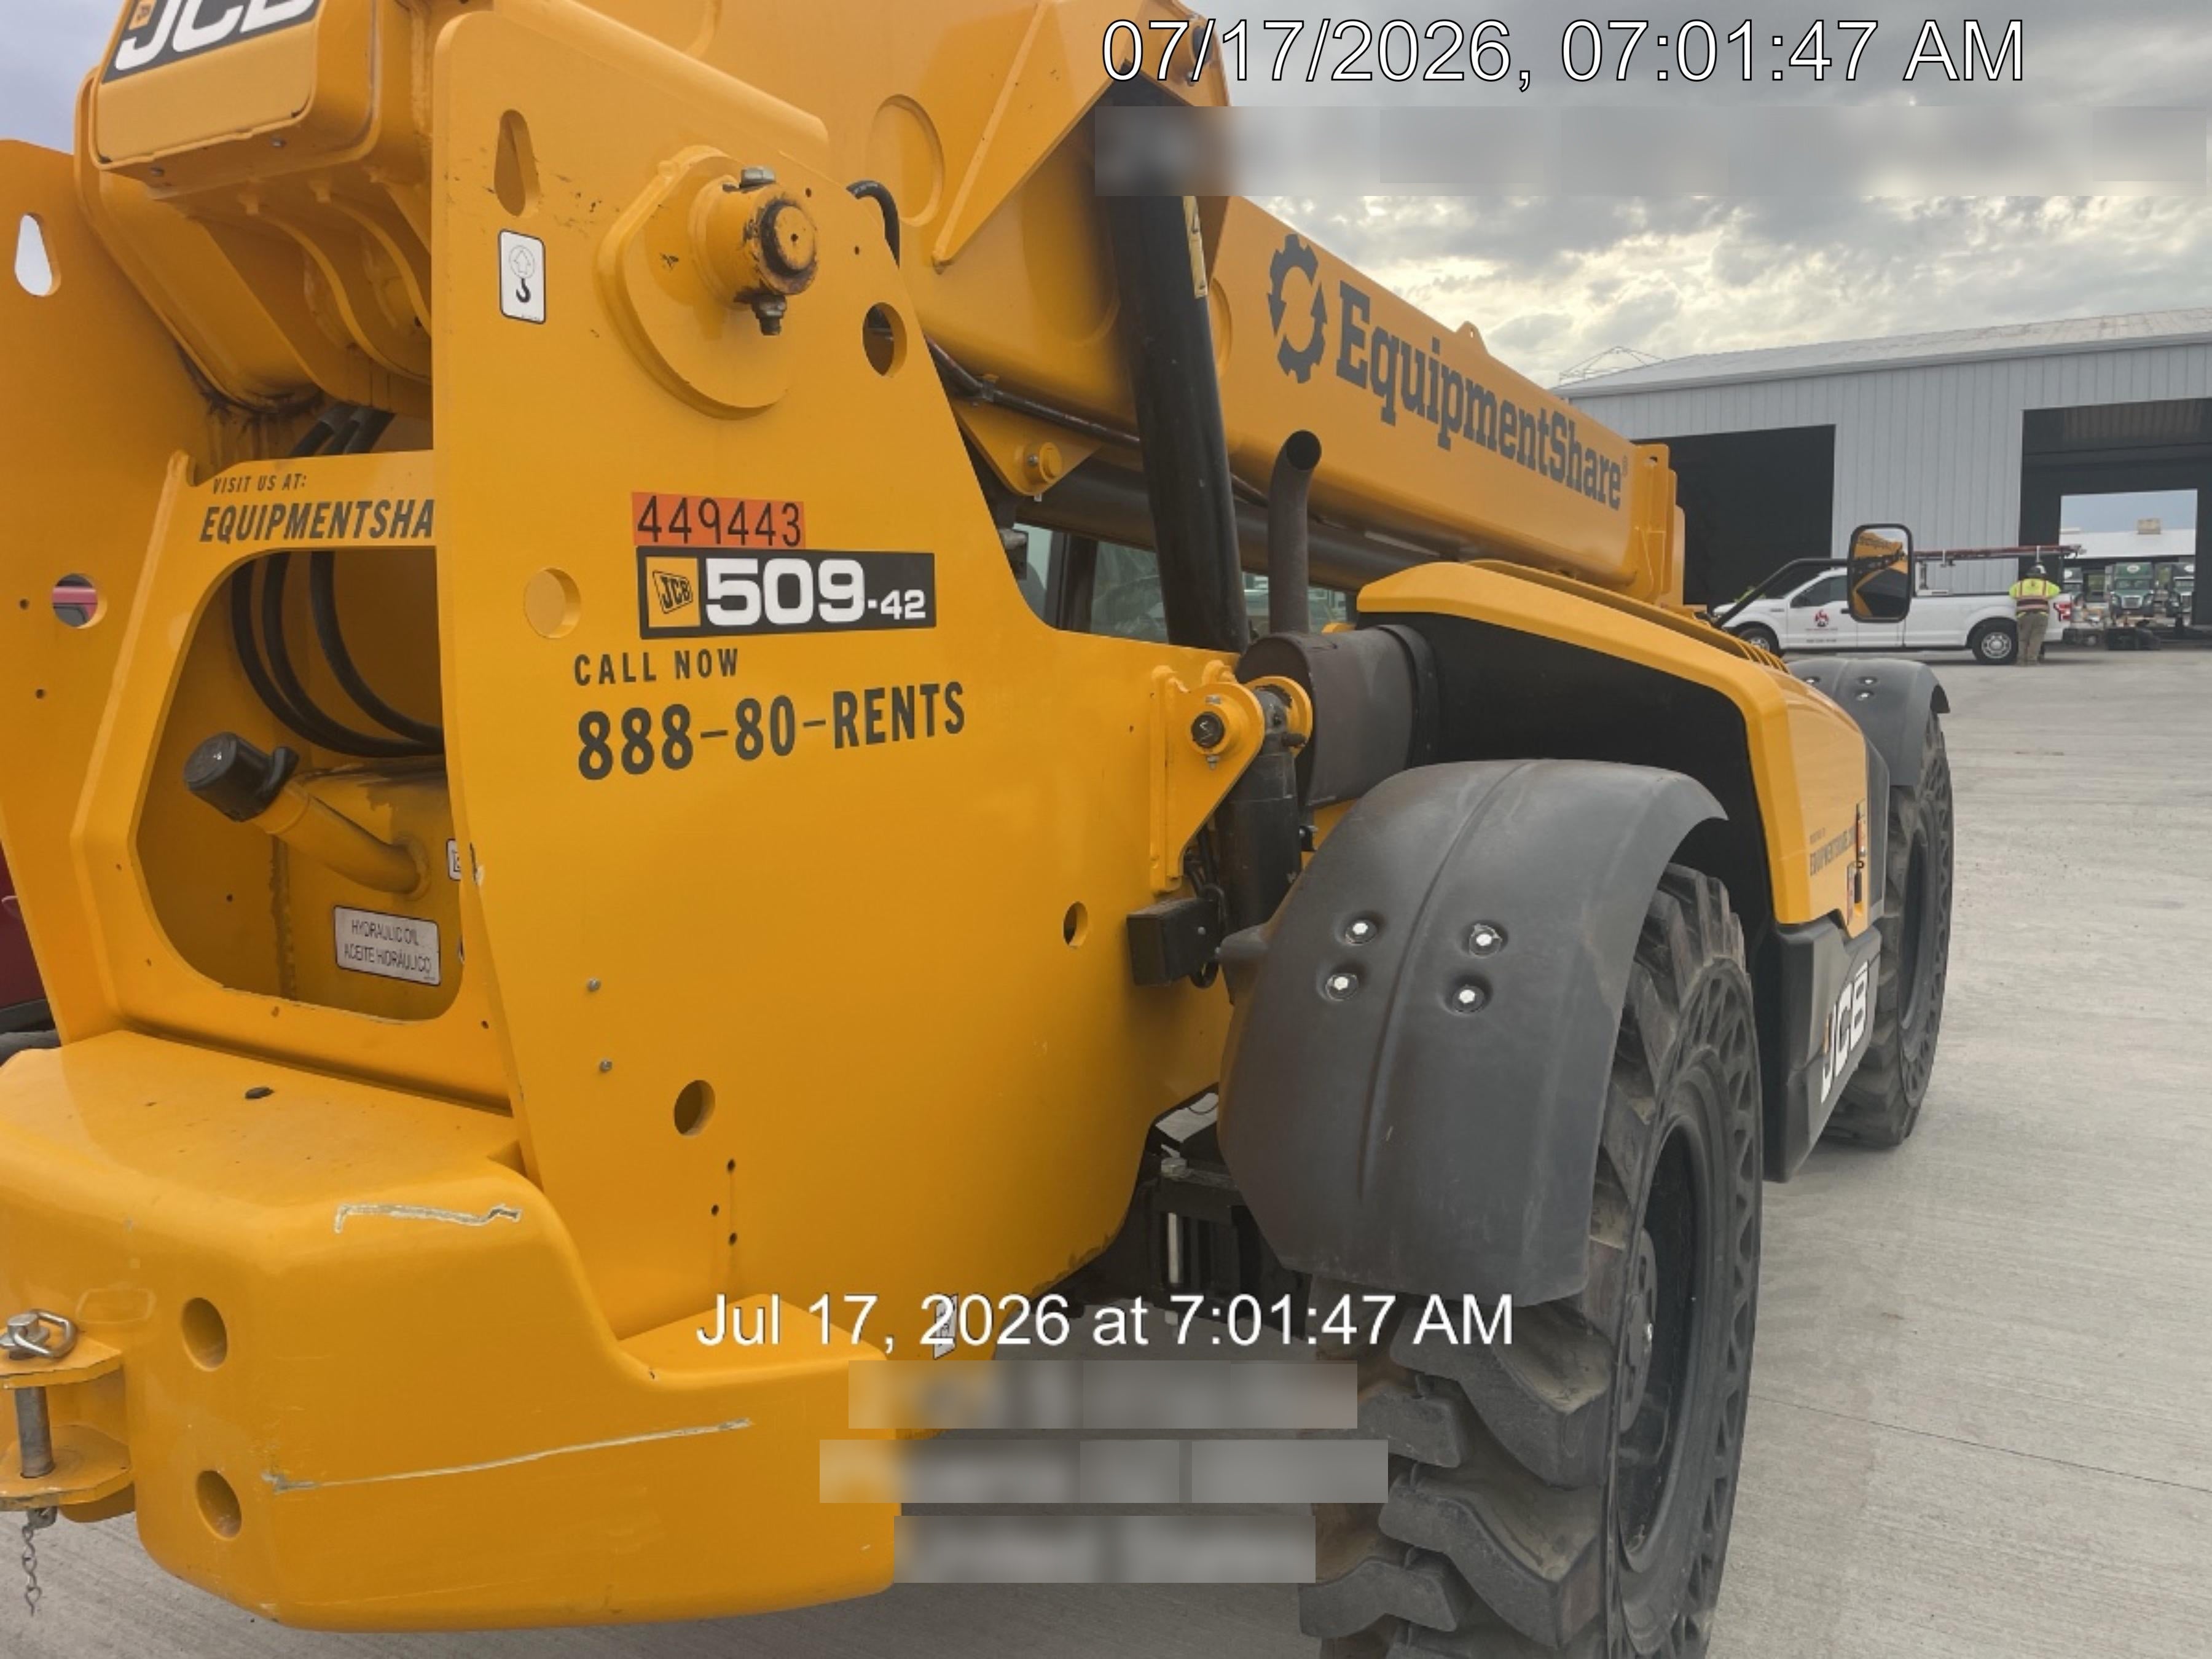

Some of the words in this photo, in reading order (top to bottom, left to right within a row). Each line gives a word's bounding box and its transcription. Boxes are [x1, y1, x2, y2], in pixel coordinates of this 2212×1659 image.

[1336, 280, 1621, 511] EquipmentShare
[213, 476, 251, 494] VISIT
[257, 475, 277, 492] US
[282, 473, 307, 490] AT:
[200, 498, 435, 544] EQUIPMENTSHA
[637, 495, 801, 547] 449443
[659, 574, 692, 610] JCB
[574, 651, 656, 686] CALL
[674, 648, 738, 679] NOW
[578, 681, 965, 780] 888-80-RENTS
[344, 943, 375, 963] ACEITE
[351, 919, 402, 943] HYDRAULIC
[404, 928, 419, 946] OIL
[1821, 960, 1869, 1104] JCB
